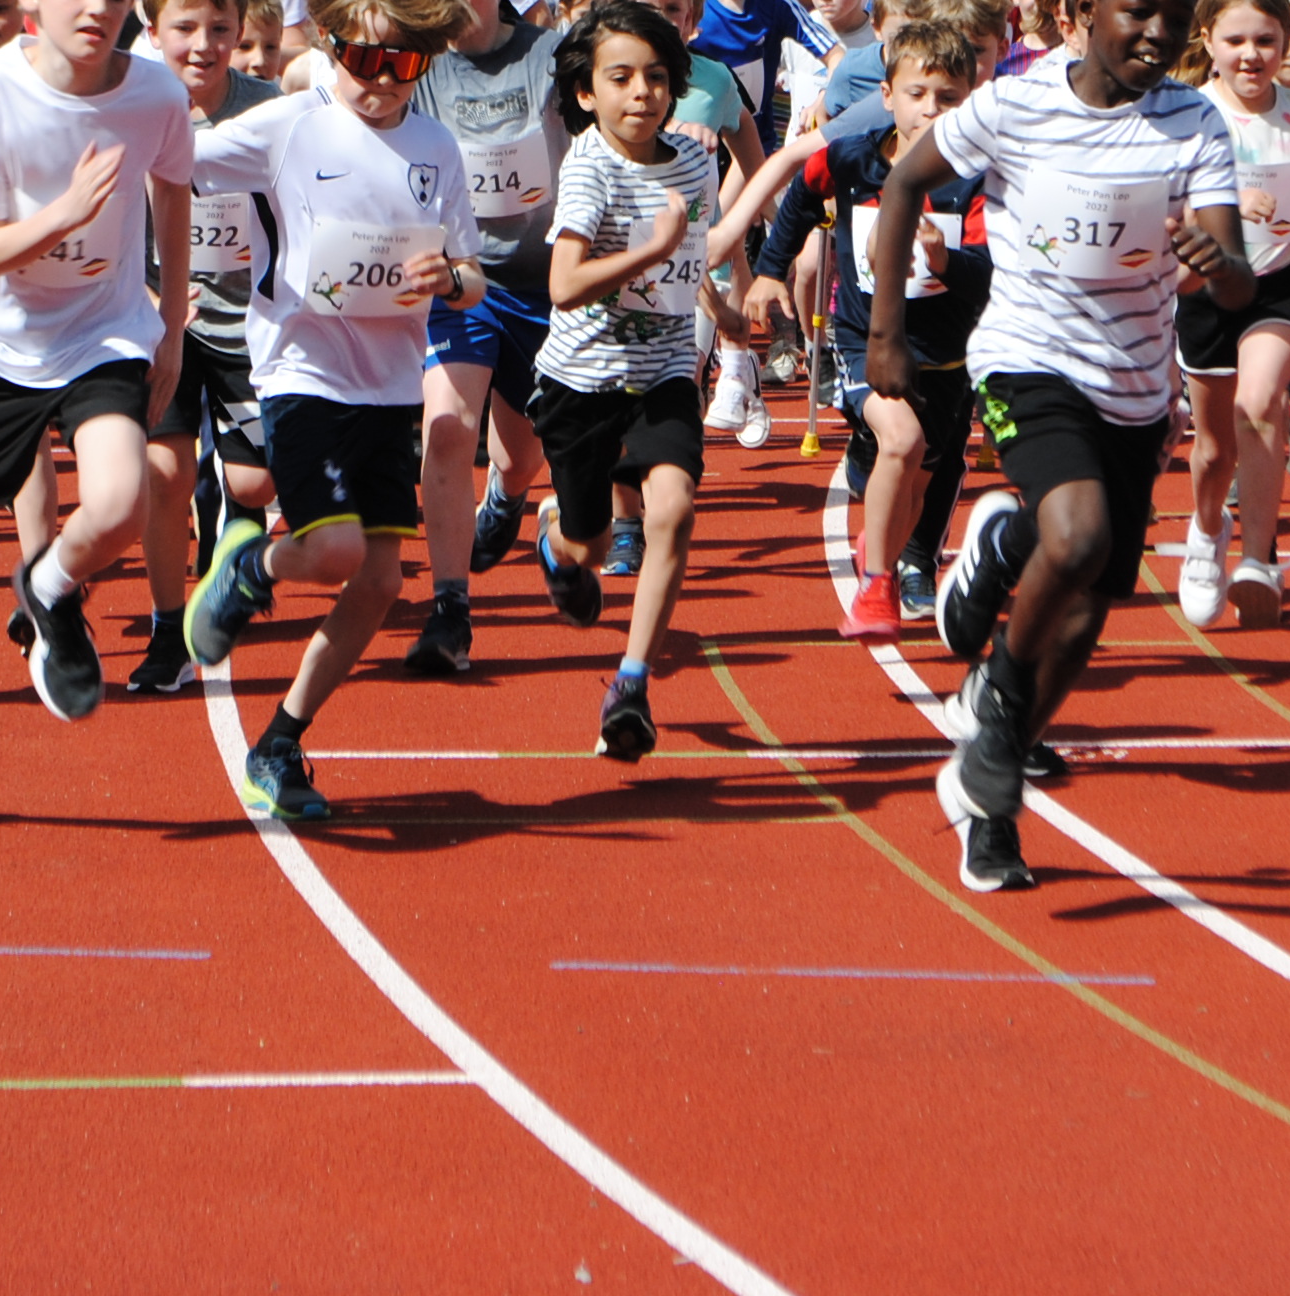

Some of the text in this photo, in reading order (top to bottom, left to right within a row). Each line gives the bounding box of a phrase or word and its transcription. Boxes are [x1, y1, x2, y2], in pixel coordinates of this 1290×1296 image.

[472, 170, 521, 193] 214
[1066, 184, 1090, 198] Peter
[1092, 189, 1111, 200] Pan
[1085, 201, 1108, 212] 2022
[190, 226, 240, 248] 322
[1062, 216, 1127, 248] 317
[39, 239, 85, 262] 41
[346, 261, 404, 288] 206
[660, 259, 702, 284] 245
